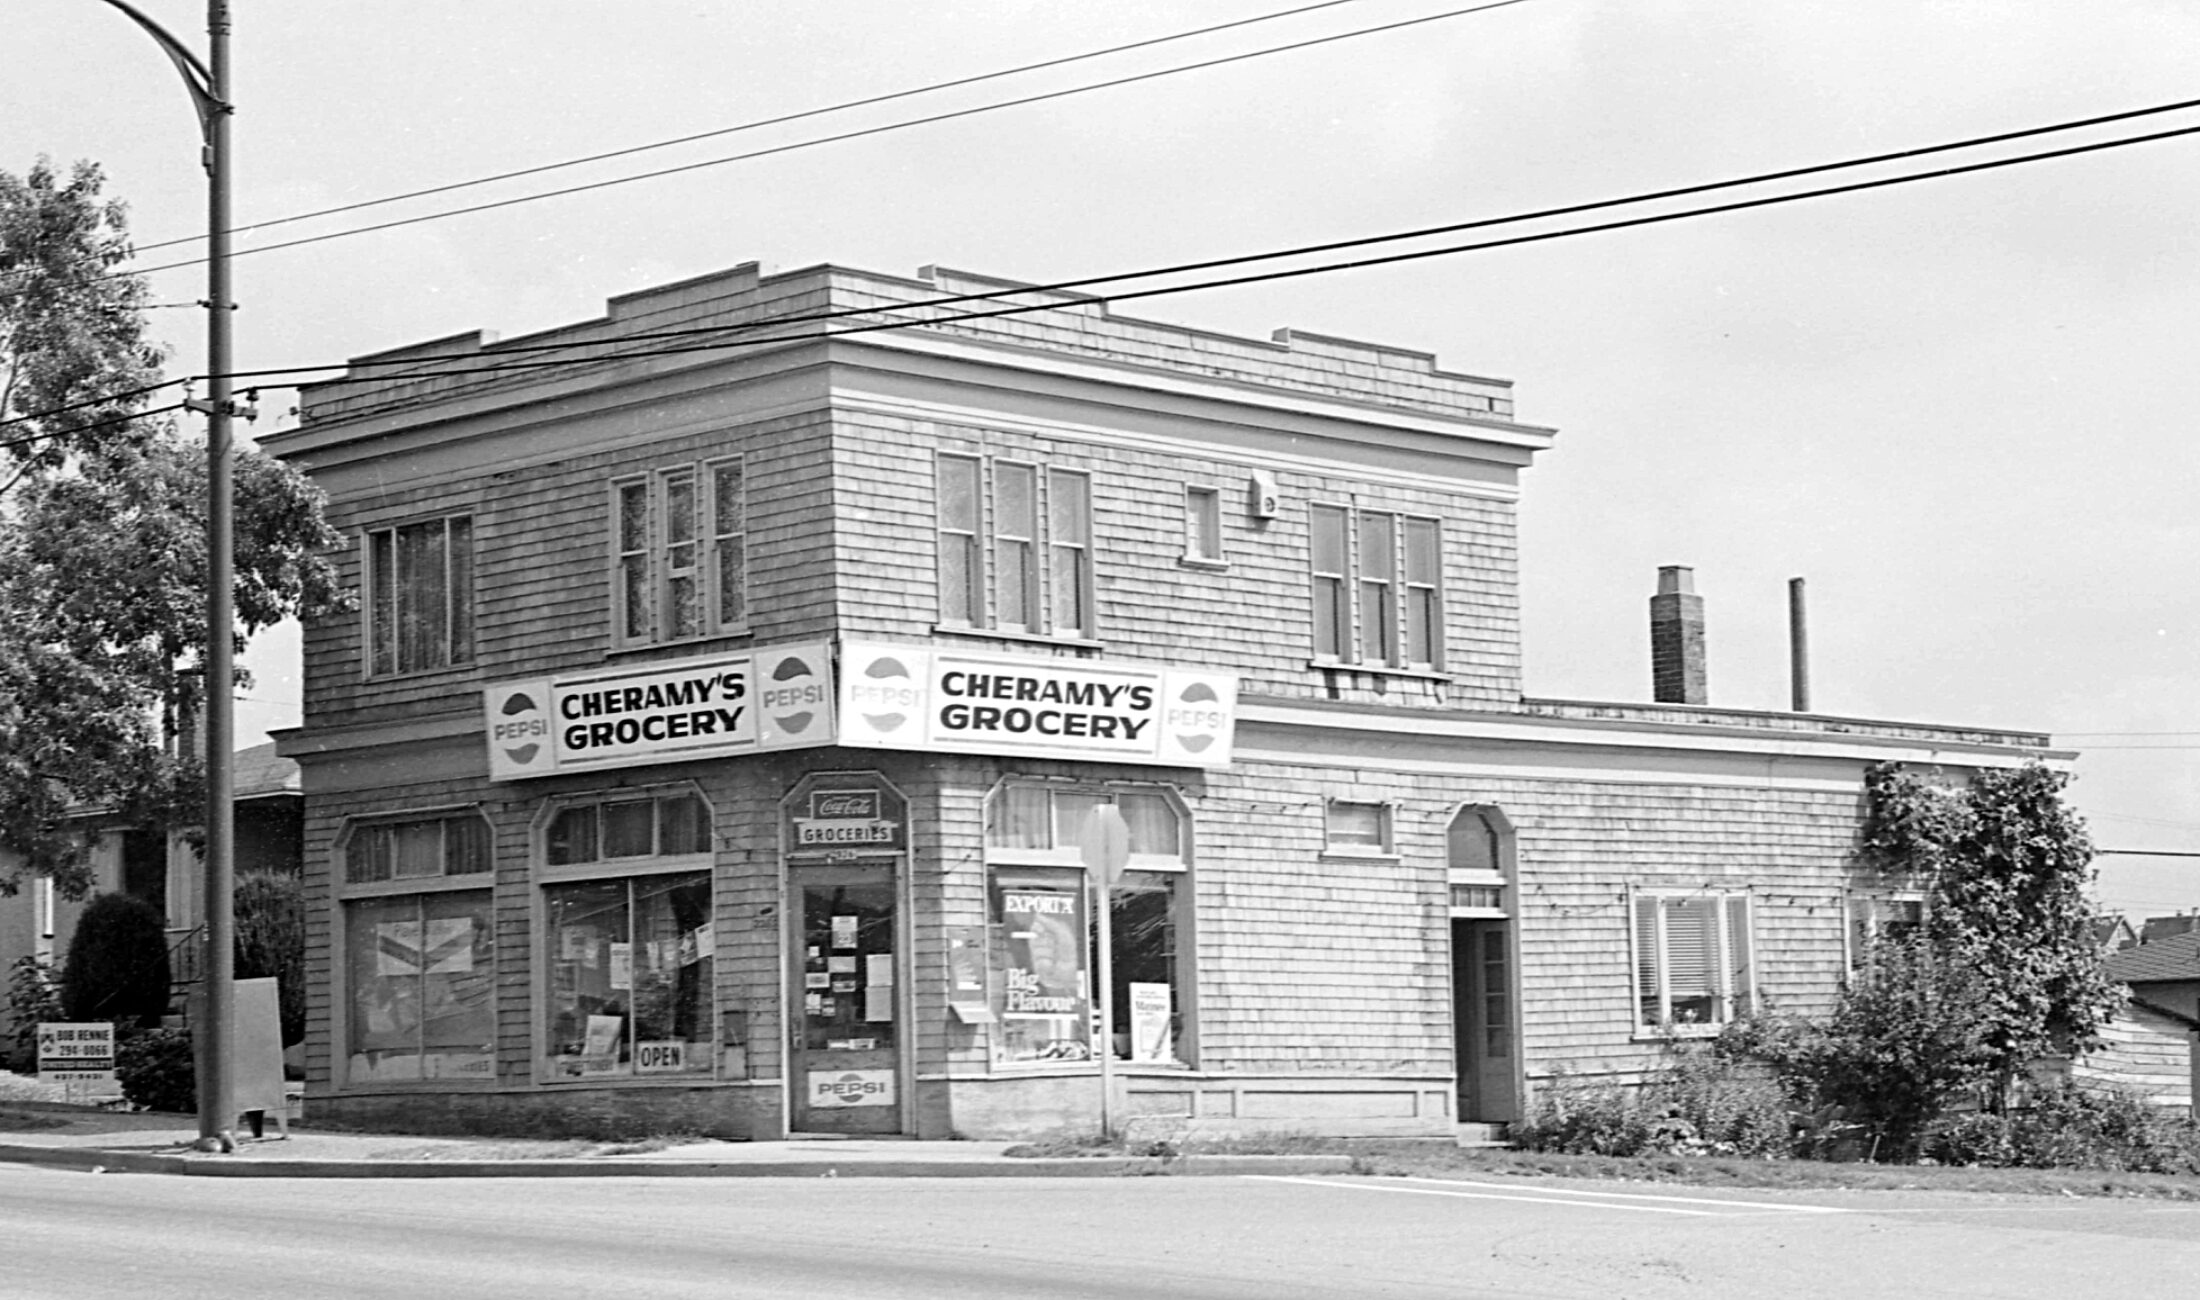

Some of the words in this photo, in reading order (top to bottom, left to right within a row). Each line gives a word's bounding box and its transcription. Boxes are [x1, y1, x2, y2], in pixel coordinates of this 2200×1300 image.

[561, 673, 746, 720] CHERAMY'S
[762, 685, 824, 708] PEPSI
[851, 684, 921, 707] PEPSI
[940, 671, 1154, 710] CHERAMY'S
[493, 718, 548, 741] PEPSI
[564, 705, 746, 750] GROCERY
[939, 704, 1151, 740] GROCERY
[1167, 708, 1227, 730] PEPSI
[819, 798, 872, 815] Coca-Cola
[804, 827, 889, 842] GROCERIES
[1007, 967, 1040, 996] Big
[1006, 990, 1076, 1012] Flavour
[641, 1046, 680, 1067] OPEN
[818, 1082, 885, 1095] PEPSI
